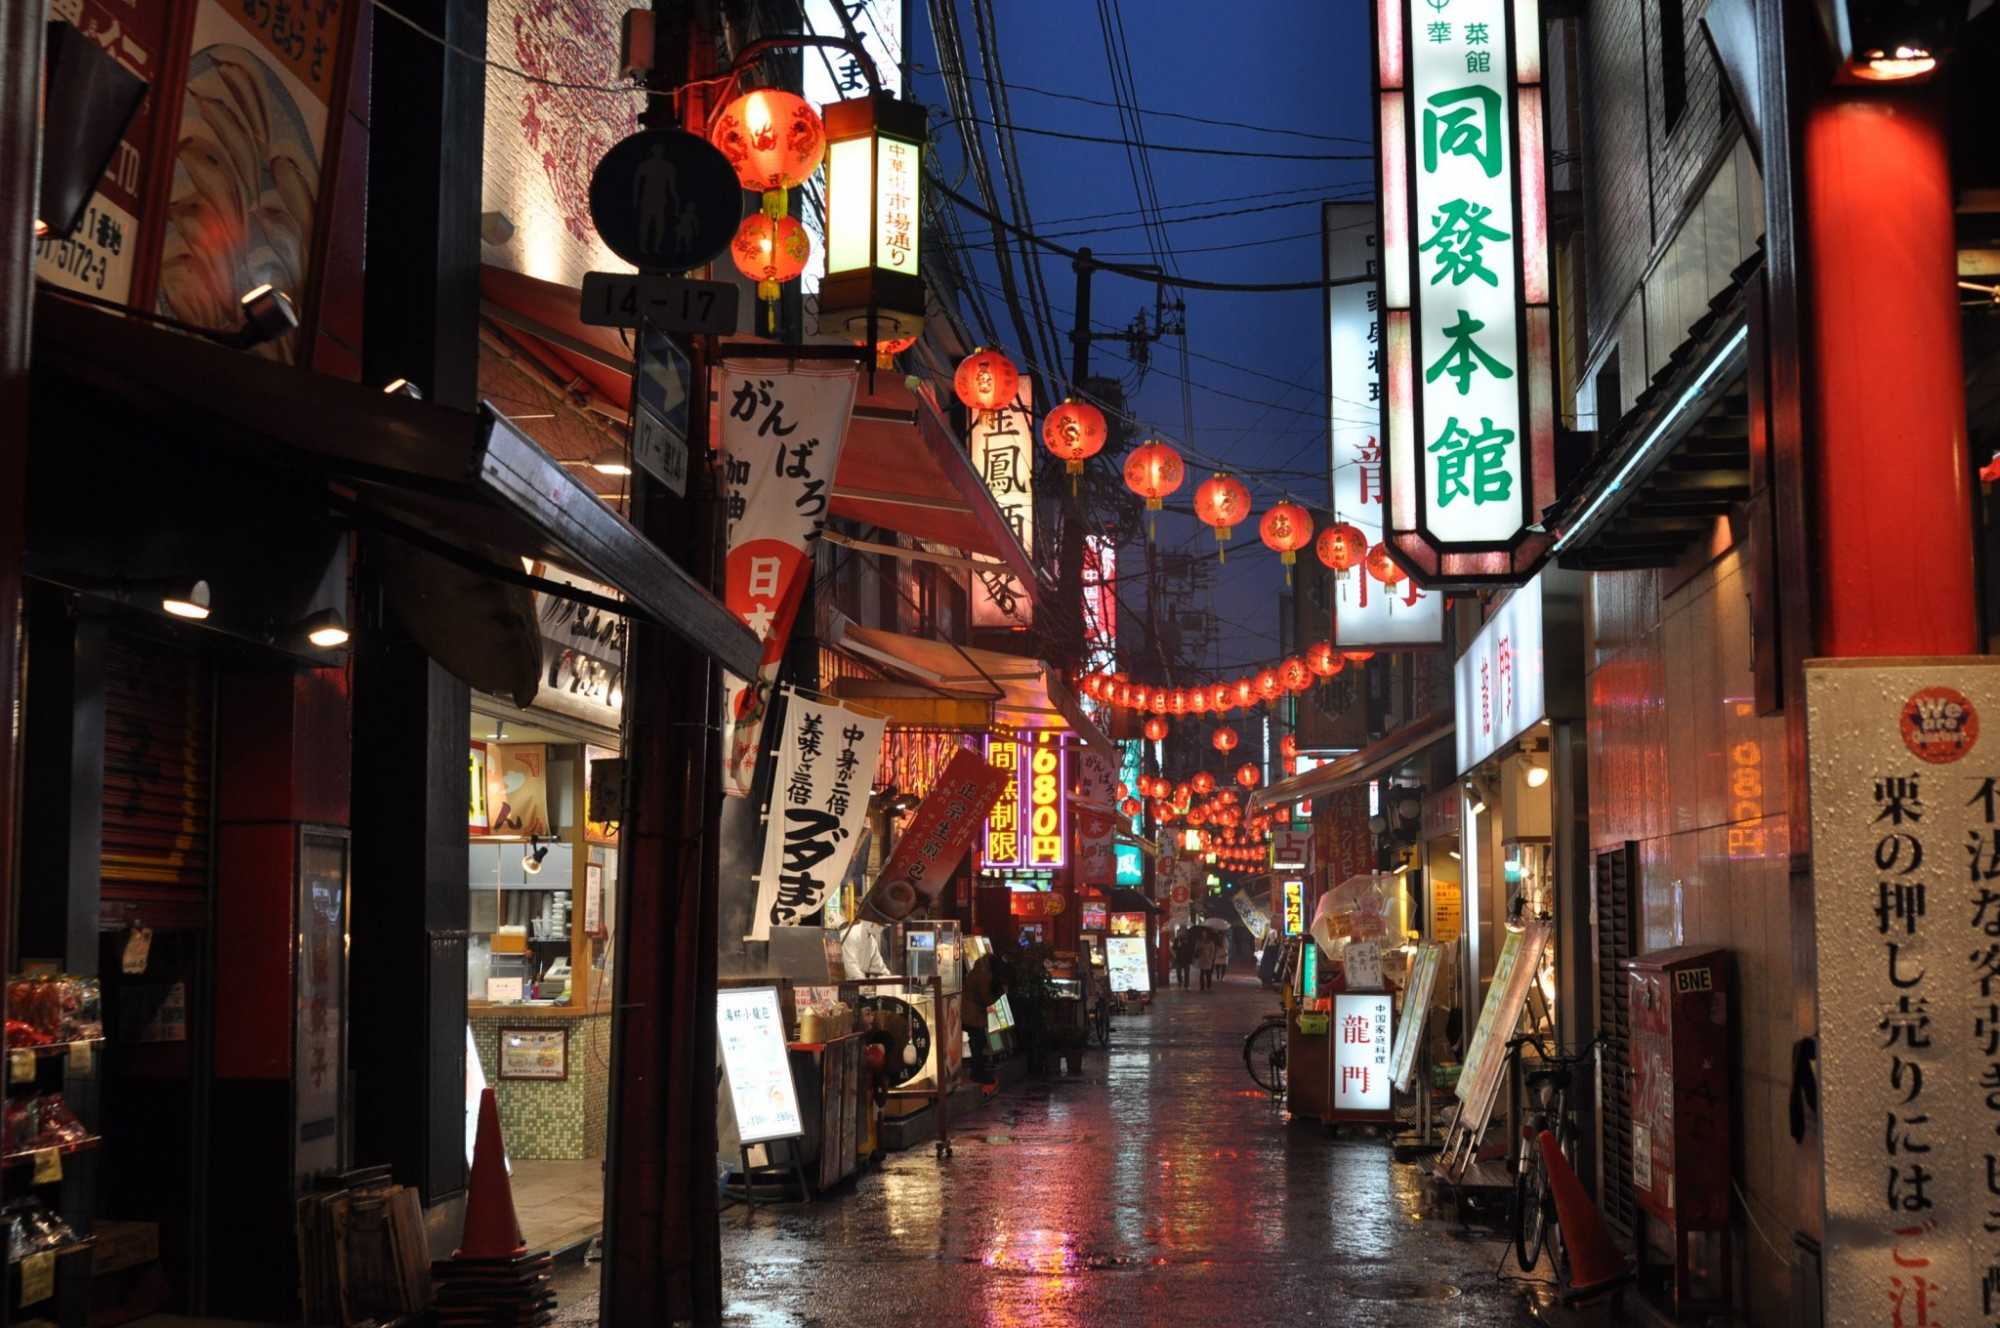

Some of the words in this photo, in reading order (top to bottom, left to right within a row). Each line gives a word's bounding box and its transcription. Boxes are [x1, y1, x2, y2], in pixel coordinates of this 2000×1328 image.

[1418, 85, 1515, 508] 同發本館
[1677, 969, 1712, 992] BNE
[1343, 1013, 1371, 1094] 龍門
